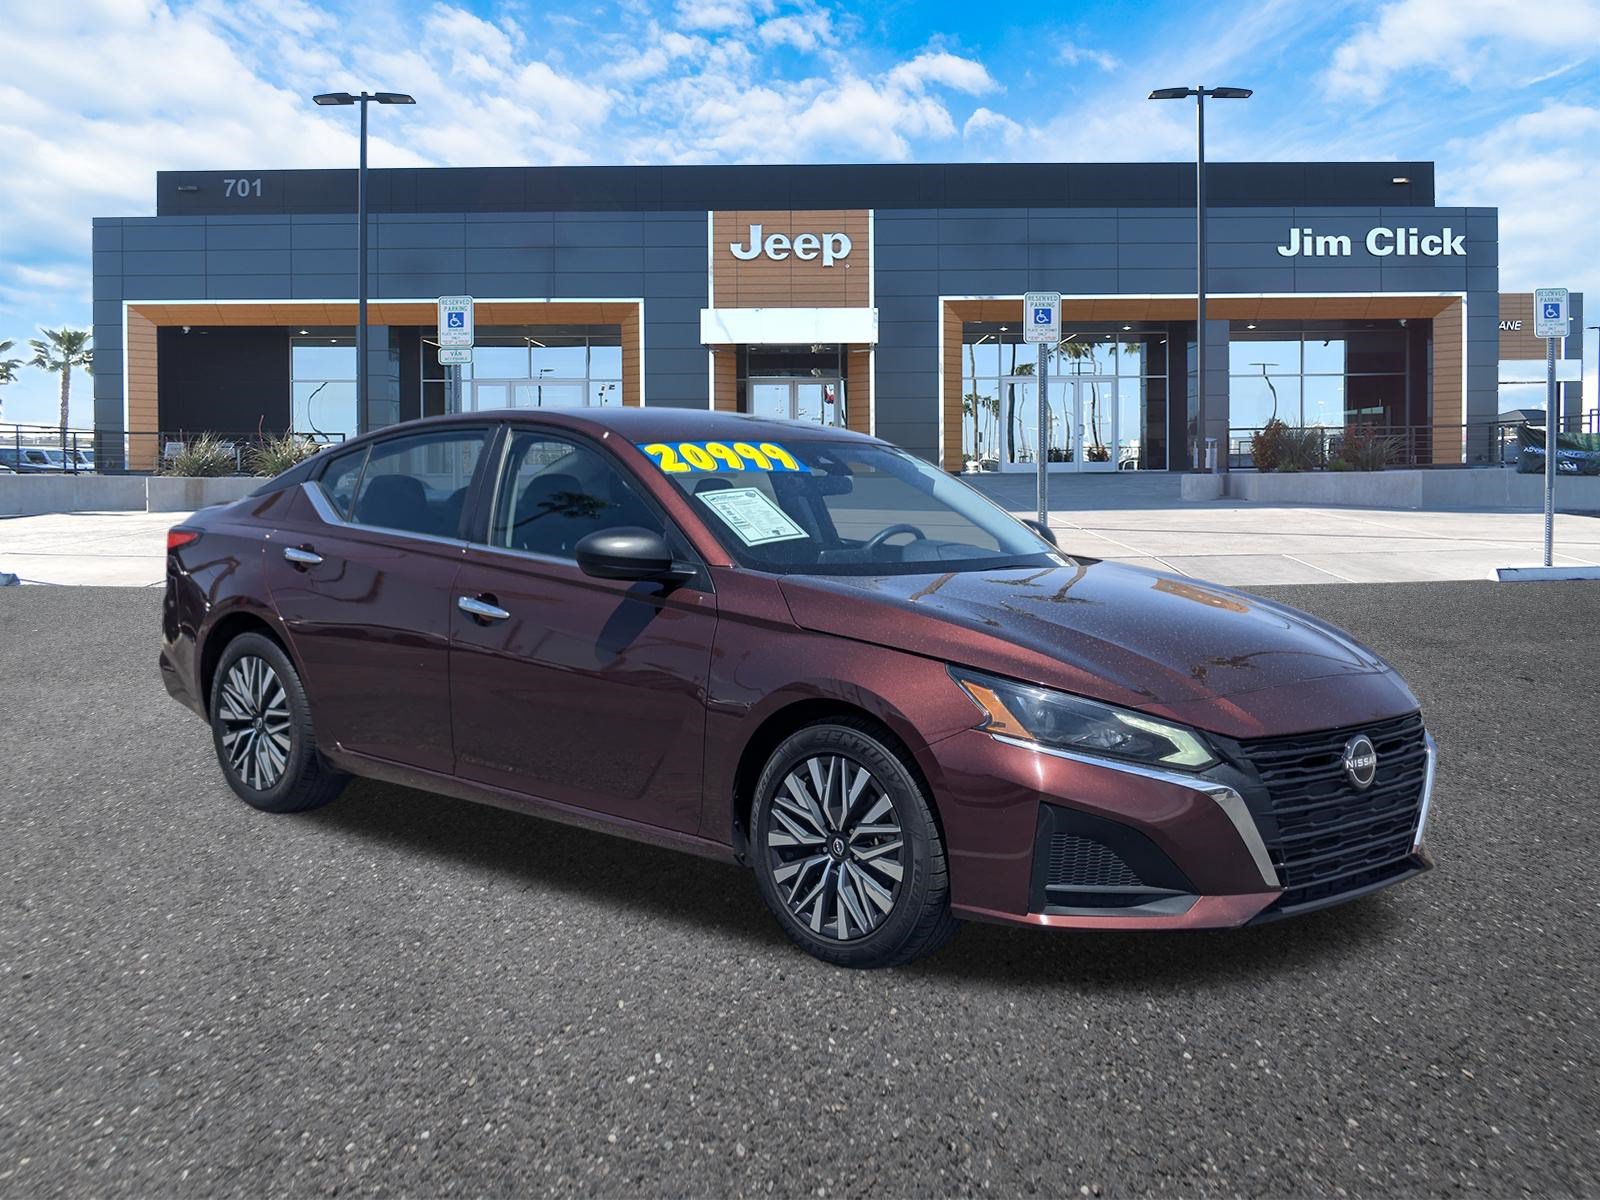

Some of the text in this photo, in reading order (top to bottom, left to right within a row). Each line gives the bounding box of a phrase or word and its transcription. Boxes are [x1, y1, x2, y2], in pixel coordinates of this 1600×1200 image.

[223, 178, 261, 197] 701
[730, 224, 852, 267] Jeep
[1277, 227, 1467, 257] Jim Click
[644, 442, 800, 472] 20999
